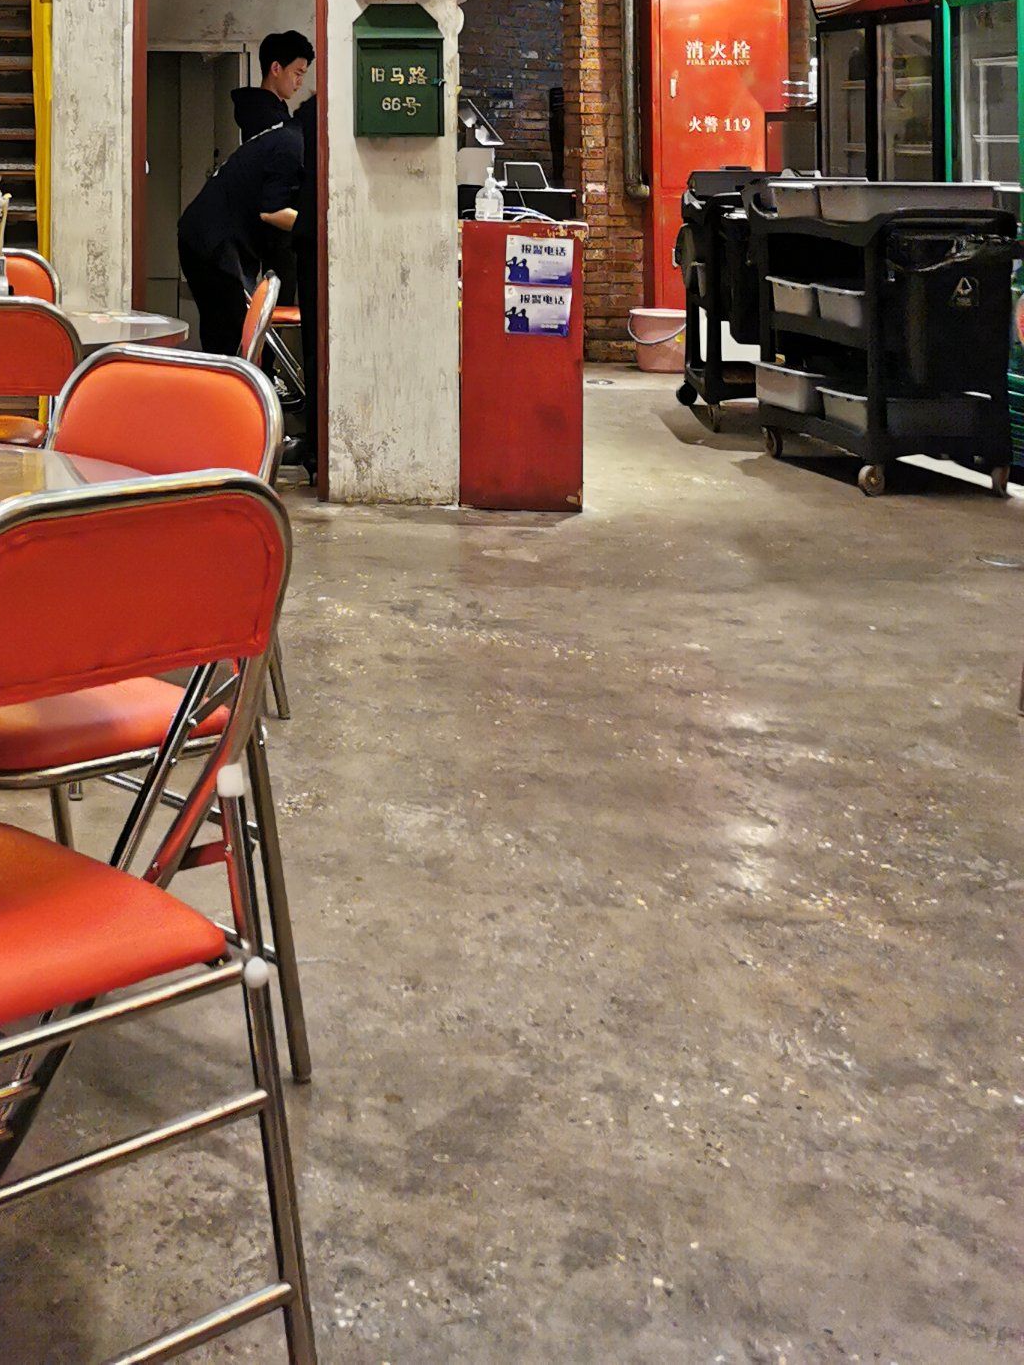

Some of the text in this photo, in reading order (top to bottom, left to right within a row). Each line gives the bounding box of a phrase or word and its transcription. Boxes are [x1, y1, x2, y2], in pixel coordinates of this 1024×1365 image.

[686, 40, 751, 59] 消火栓
[371, 66, 428, 84] 旧马路
[381, 96, 422, 116] 66号
[688, 115, 751, 133] 火警 119
[521, 243, 567, 256] 报警电话
[520, 293, 565, 305] 报警电话
